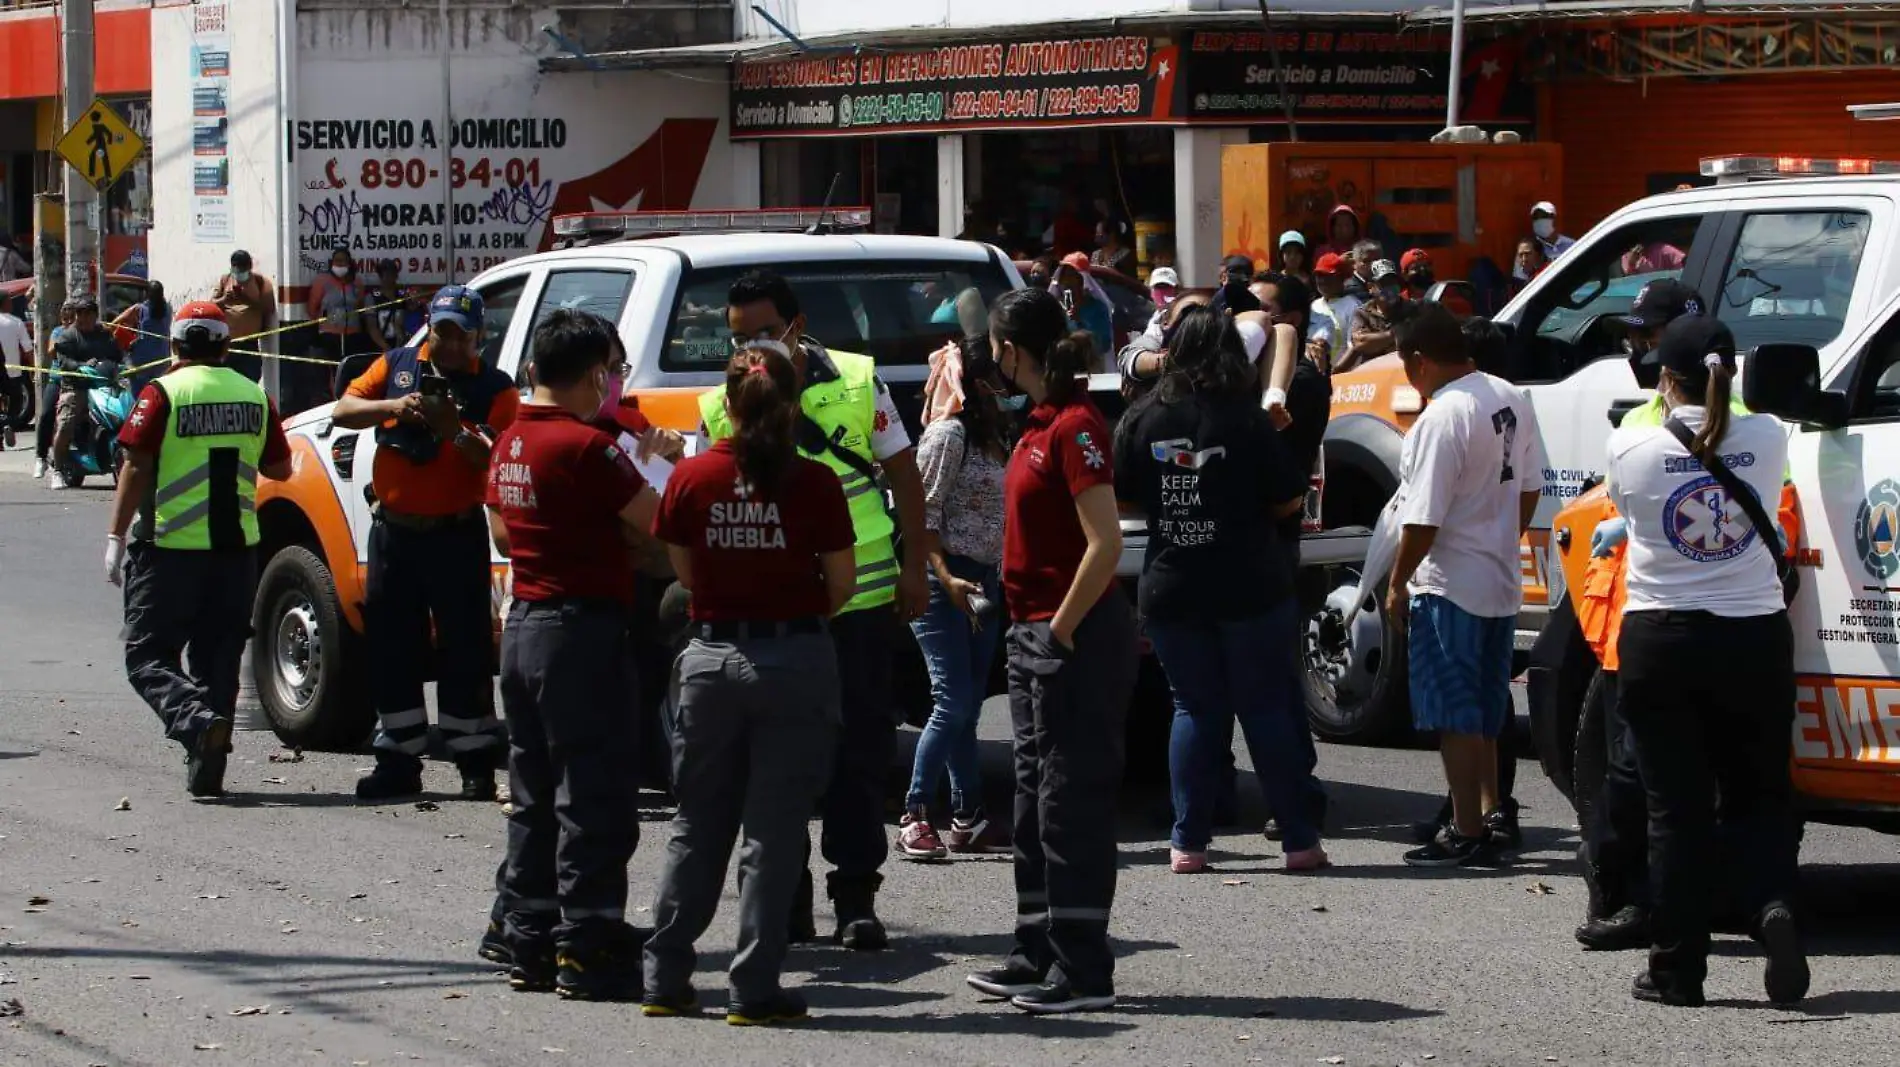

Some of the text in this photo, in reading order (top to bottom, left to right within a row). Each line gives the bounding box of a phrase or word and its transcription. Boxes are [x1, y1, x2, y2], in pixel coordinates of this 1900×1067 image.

[733, 36, 1148, 90] PROFESIONALES EN REFACCIONES AUTOMOTRICES
[1320, 69, 1330, 84] a
[1336, 63, 1417, 84] Domicilio
[736, 103, 776, 125] Servicio
[777, 110, 786, 124] a
[786, 101, 835, 124] Domicilio
[853, 93, 944, 124] 2221-58-65-90
[952, 89, 1039, 118] 222-890-84-01
[1049, 84, 1140, 116] 222-399-86-58
[297, 119, 414, 149] SERVICIO
[421, 119, 437, 149] A
[300, 234, 350, 250] LUNES
[353, 234, 364, 250] A
[367, 233, 428, 250] SABADO
[432, 233, 442, 249] 8
[408, 258, 420, 273] 9
[454, 257, 466, 273] A
[1665, 452, 1755, 474] MÉCO
[499, 463, 532, 484] SUMA
[1161, 474, 1199, 490] KEEP
[1560, 469, 1584, 482] CIVIL
[1161, 491, 1202, 506] CALM
[710, 502, 781, 525] SUMA
[1172, 508, 1189, 516] AND
[1178, 520, 1216, 533] YOUR
[706, 526, 786, 549] PUEBLA
[1161, 533, 1214, 546] ASSES
[1818, 629, 1899, 645] GESTION INTEGRAL
